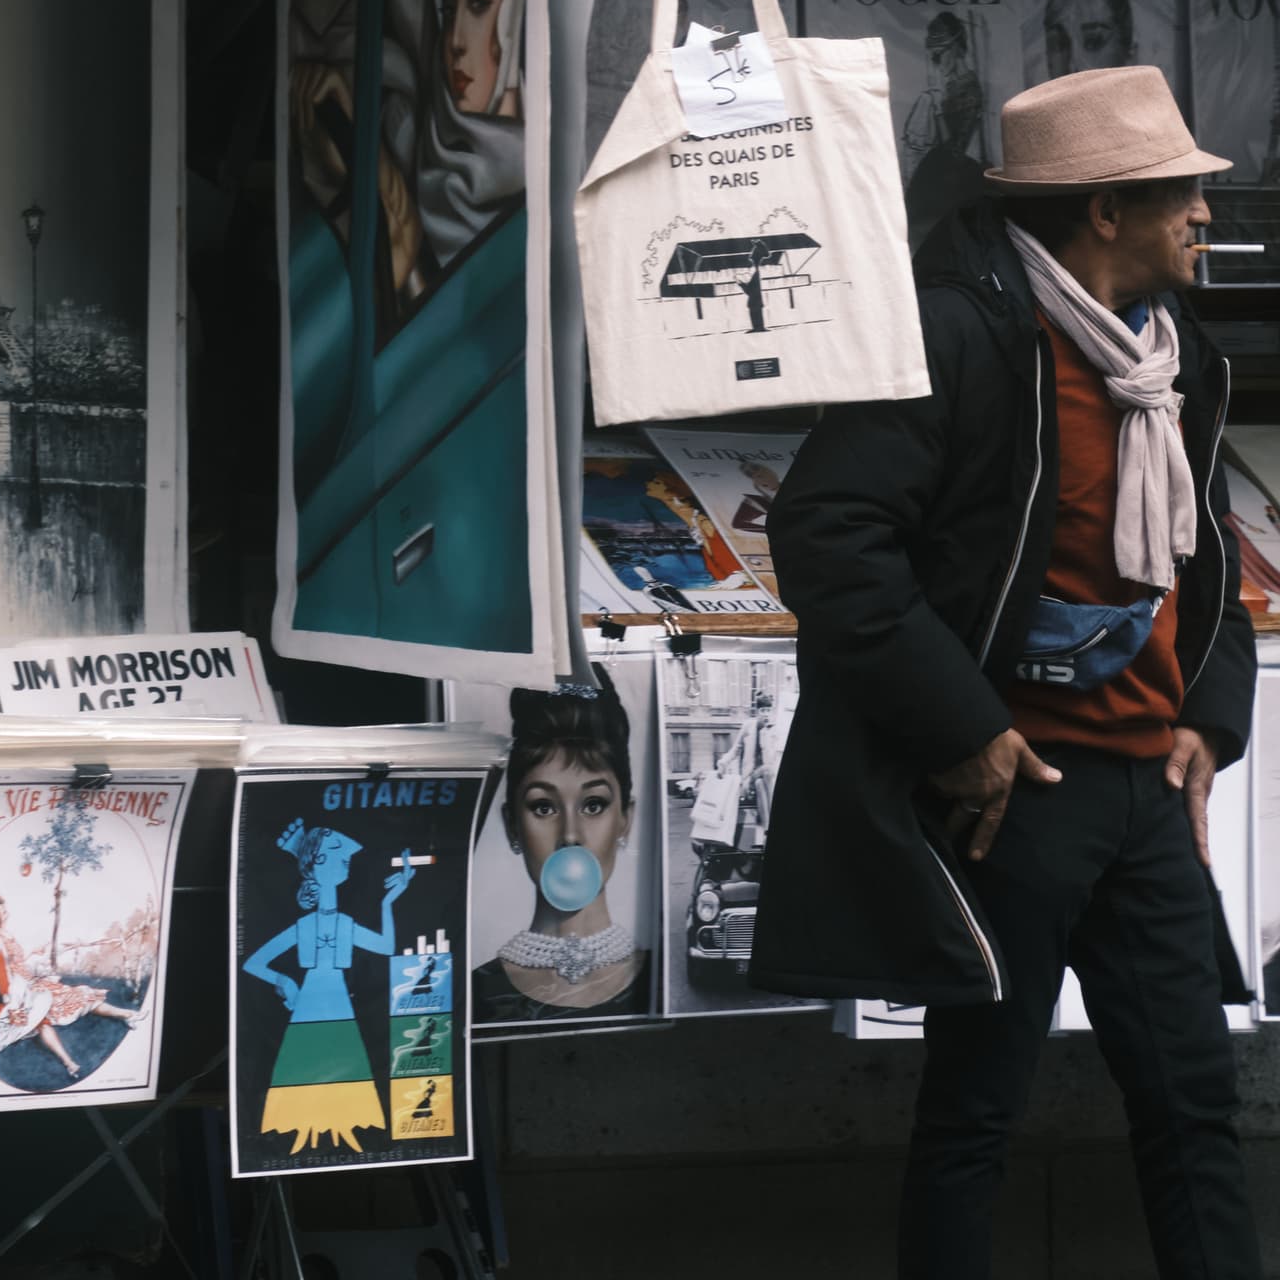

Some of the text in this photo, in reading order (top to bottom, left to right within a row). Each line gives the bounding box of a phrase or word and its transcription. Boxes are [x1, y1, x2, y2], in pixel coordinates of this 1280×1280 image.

[669, 143, 795, 169] DES QUAIS DE
[710, 171, 760, 190] PARIS
[697, 599, 781, 612] BOUR
[11, 647, 236, 691] JIM MORRISON
[78, 687, 137, 712] AGE
[5, 787, 42, 817] VIE
[322, 779, 458, 811] GITANES
